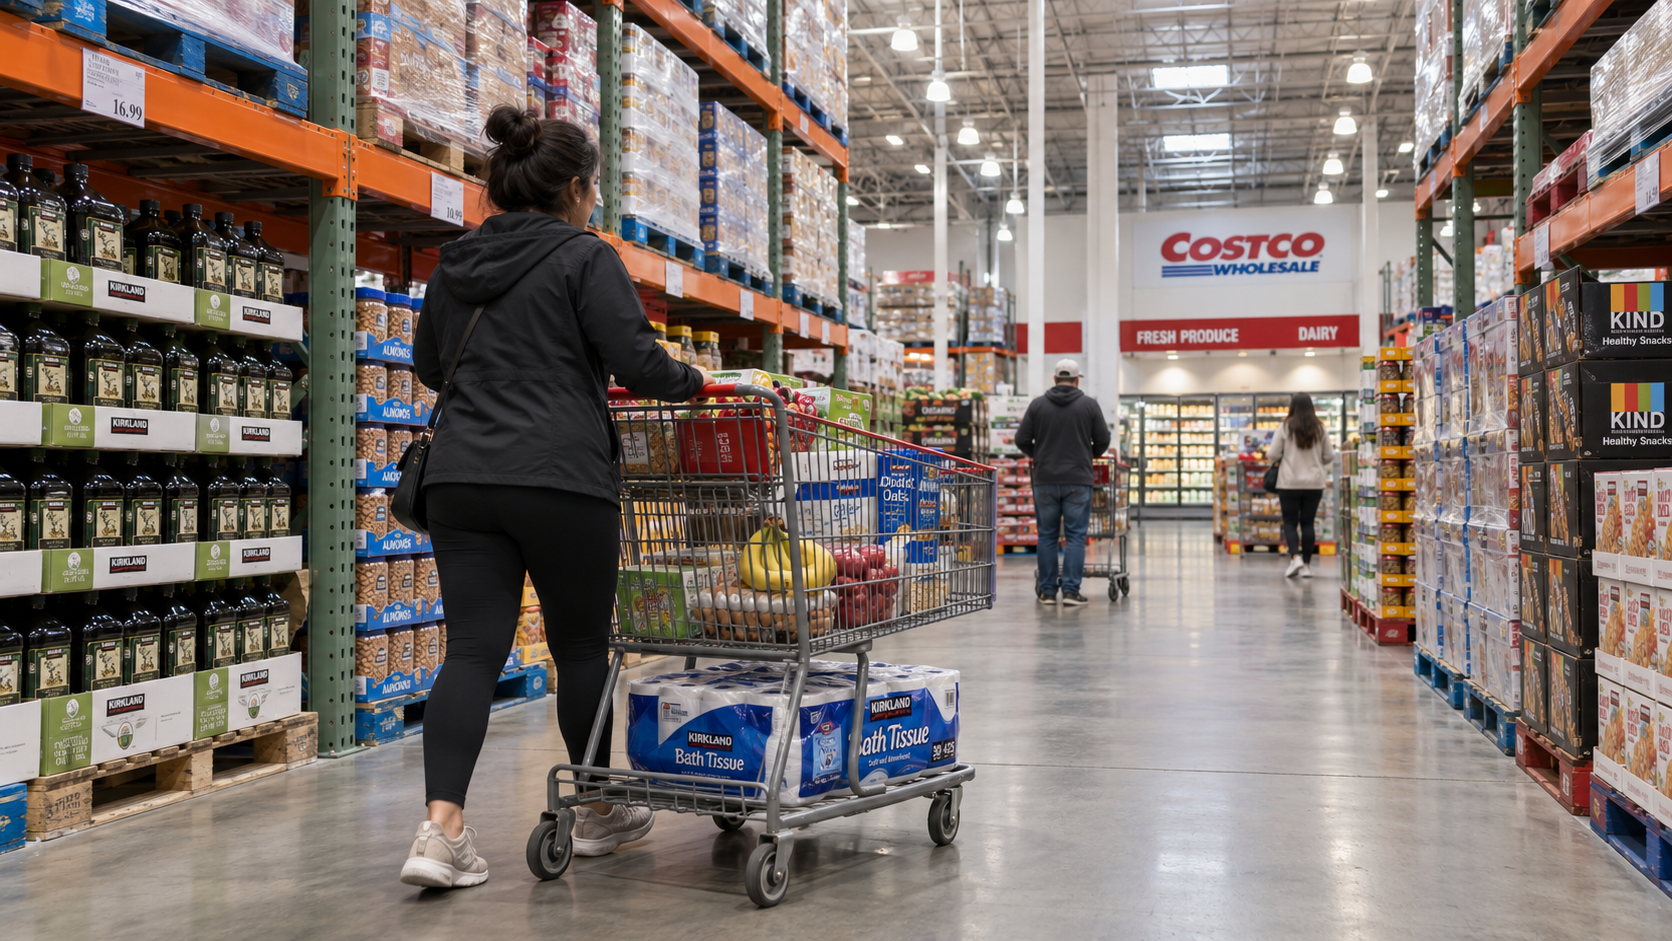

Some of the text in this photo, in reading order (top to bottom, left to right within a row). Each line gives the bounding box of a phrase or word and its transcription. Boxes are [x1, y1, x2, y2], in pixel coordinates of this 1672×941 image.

[113, 98, 142, 121] 16.99
[1160, 231, 1325, 263] COSTCO
[1213, 260, 1320, 276] WHOLESALE
[110, 281, 145, 296] KIRKLAND
[1610, 311, 1665, 329] KIND
[1136, 326, 1339, 345] FRESH PRODUCE DAIRY
[1602, 335, 1672, 347] Healthy Snacks
[112, 418, 147, 429] KIRKLAND
[1610, 411, 1665, 429] KIND
[1602, 435, 1672, 448] Healthy Snacks
[111, 557, 146, 567] KIRKLAND
[108, 695, 144, 710] KIRKLAND
[871, 696, 911, 714] KIRKLAND
[688, 731, 733, 747] KIRKLAND
[887, 723, 930, 753] Tissue
[675, 747, 745, 771] Bath Tissue
